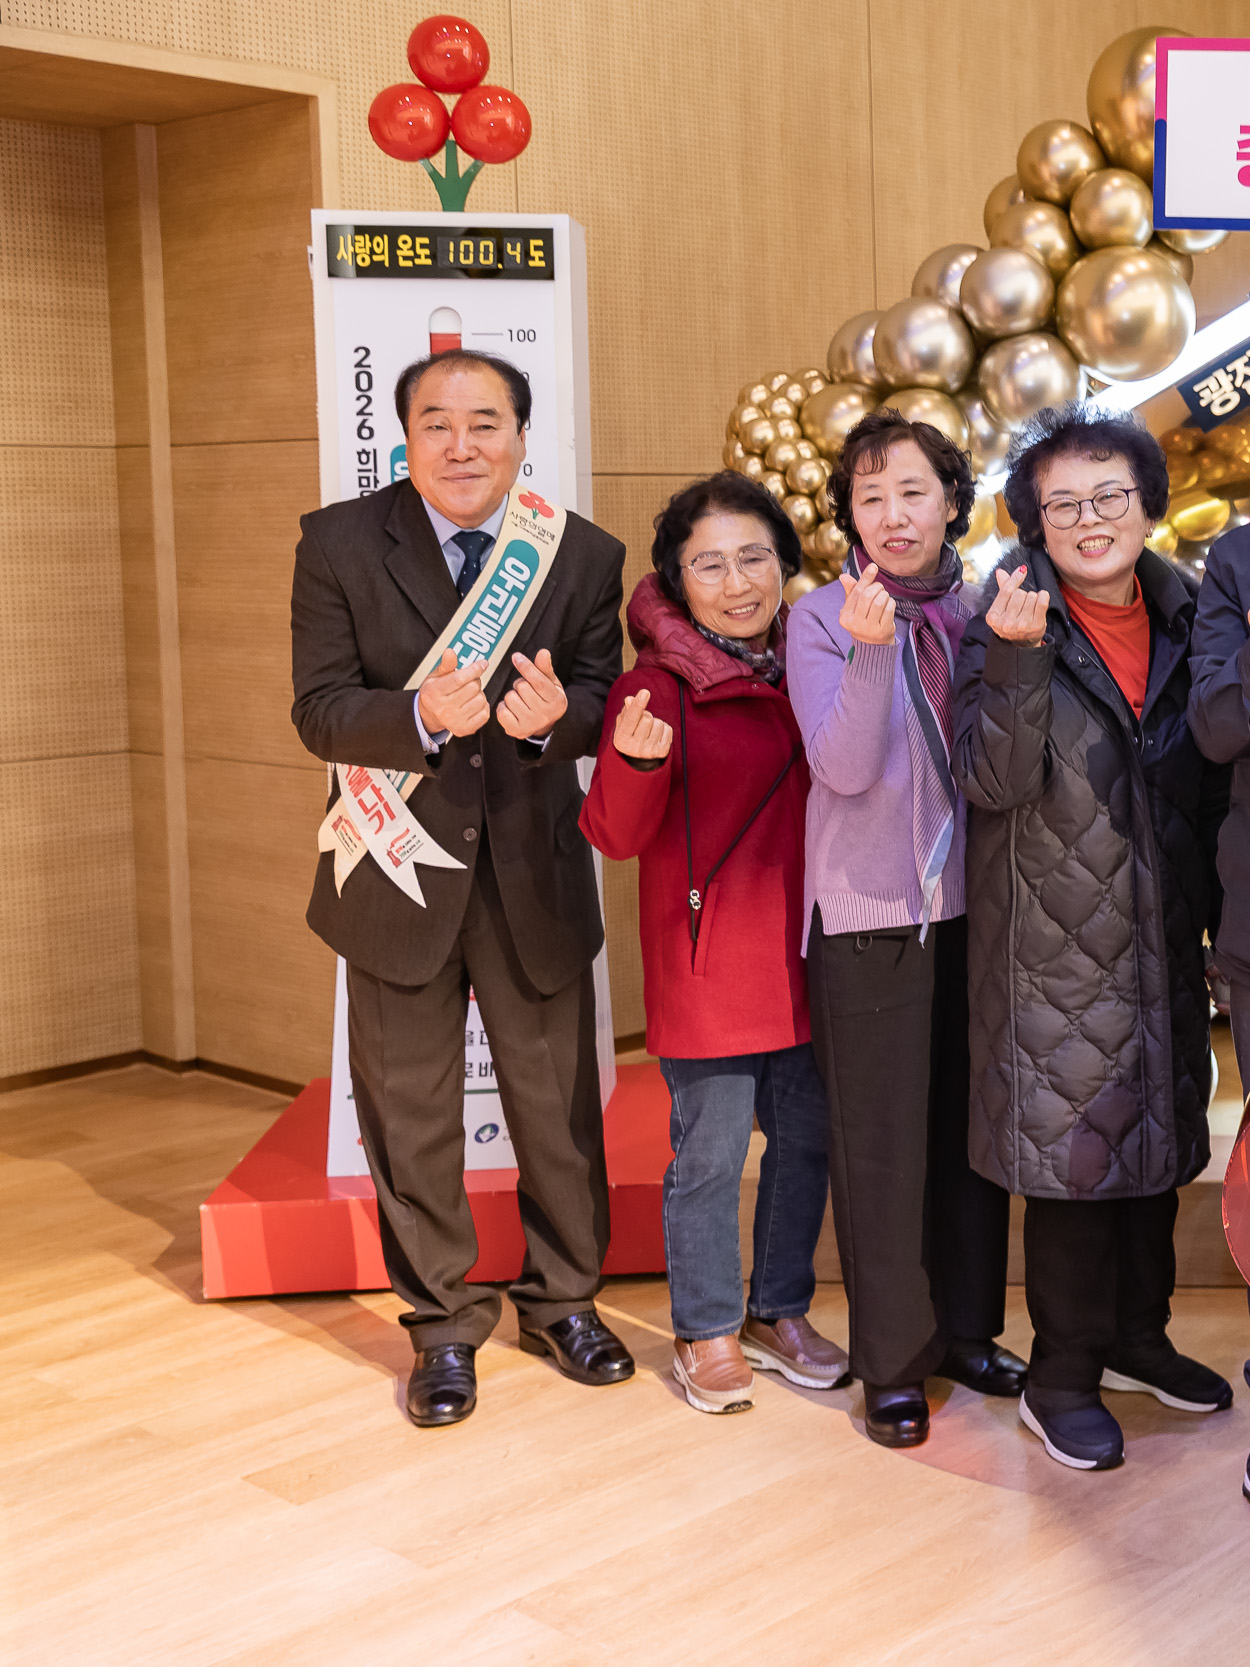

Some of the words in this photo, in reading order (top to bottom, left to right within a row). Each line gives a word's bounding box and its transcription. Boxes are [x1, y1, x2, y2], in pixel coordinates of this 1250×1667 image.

[336, 234, 389, 268] 사랑의
[396, 234, 432, 268] 온도
[508, 328, 537, 343] 100
[353, 346, 375, 441] 2026
[342, 764, 396, 835] 울나기
